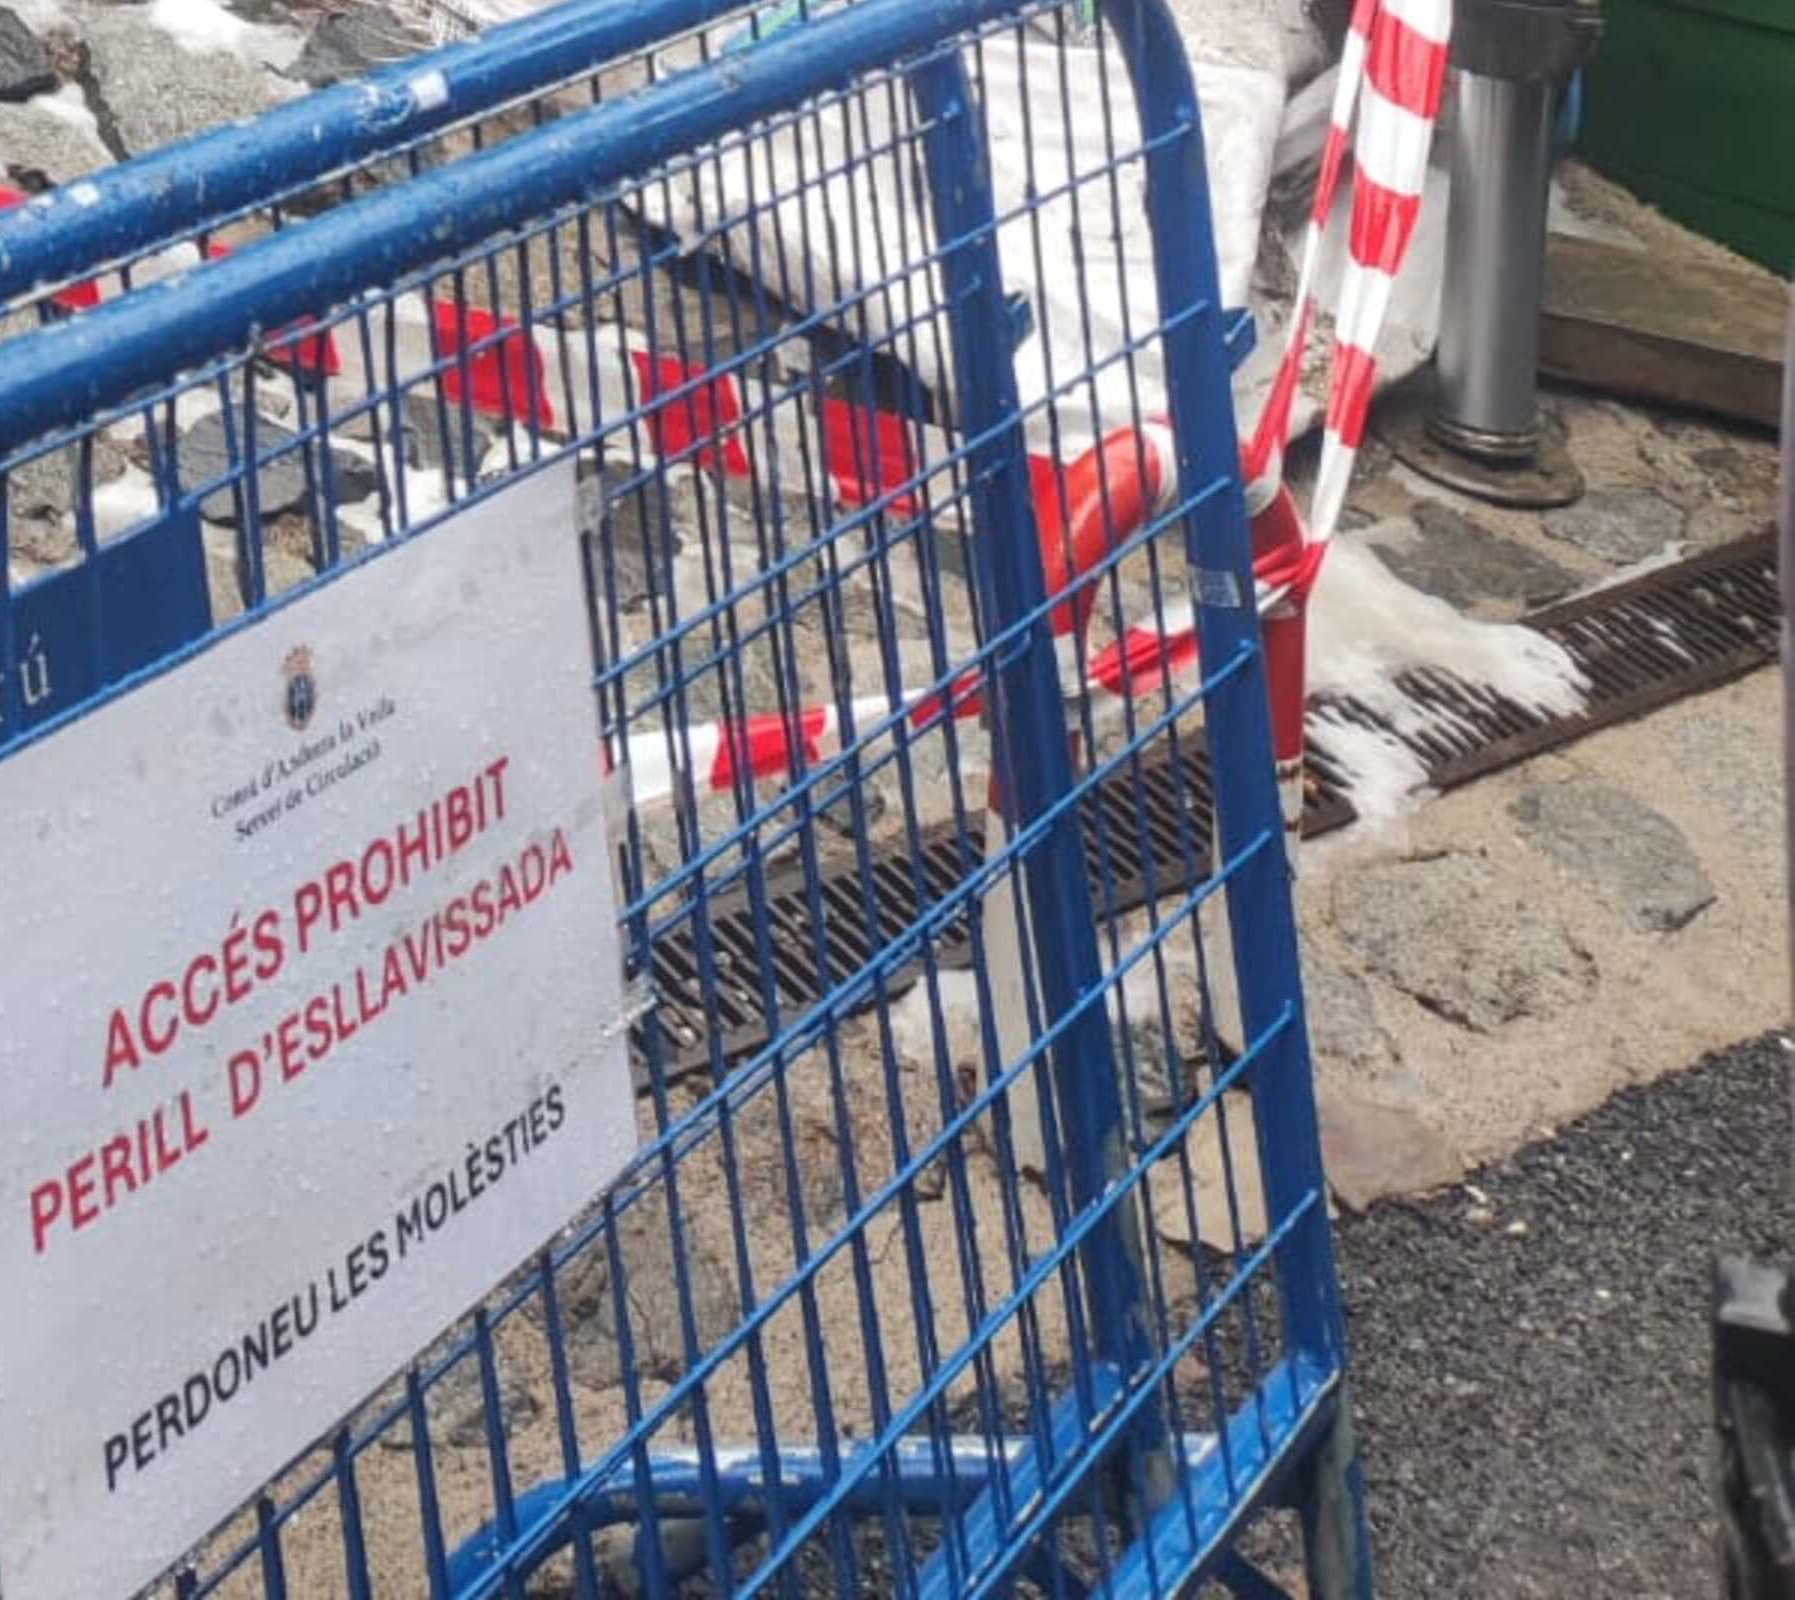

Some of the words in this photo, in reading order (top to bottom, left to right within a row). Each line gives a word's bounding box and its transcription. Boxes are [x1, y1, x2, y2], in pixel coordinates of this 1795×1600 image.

[102, 907, 285, 1089] ACCÉS
[293, 757, 509, 953] PROHIBIT
[285, 787, 303, 810] de
[30, 1091, 209, 1254] PERILL
[227, 827, 574, 1119] D'ESLLAVISSADA
[104, 1282, 318, 1492] PERDONEU
[330, 1231, 390, 1312] LES
[395, 1085, 566, 1257] MOLÈSTIES
